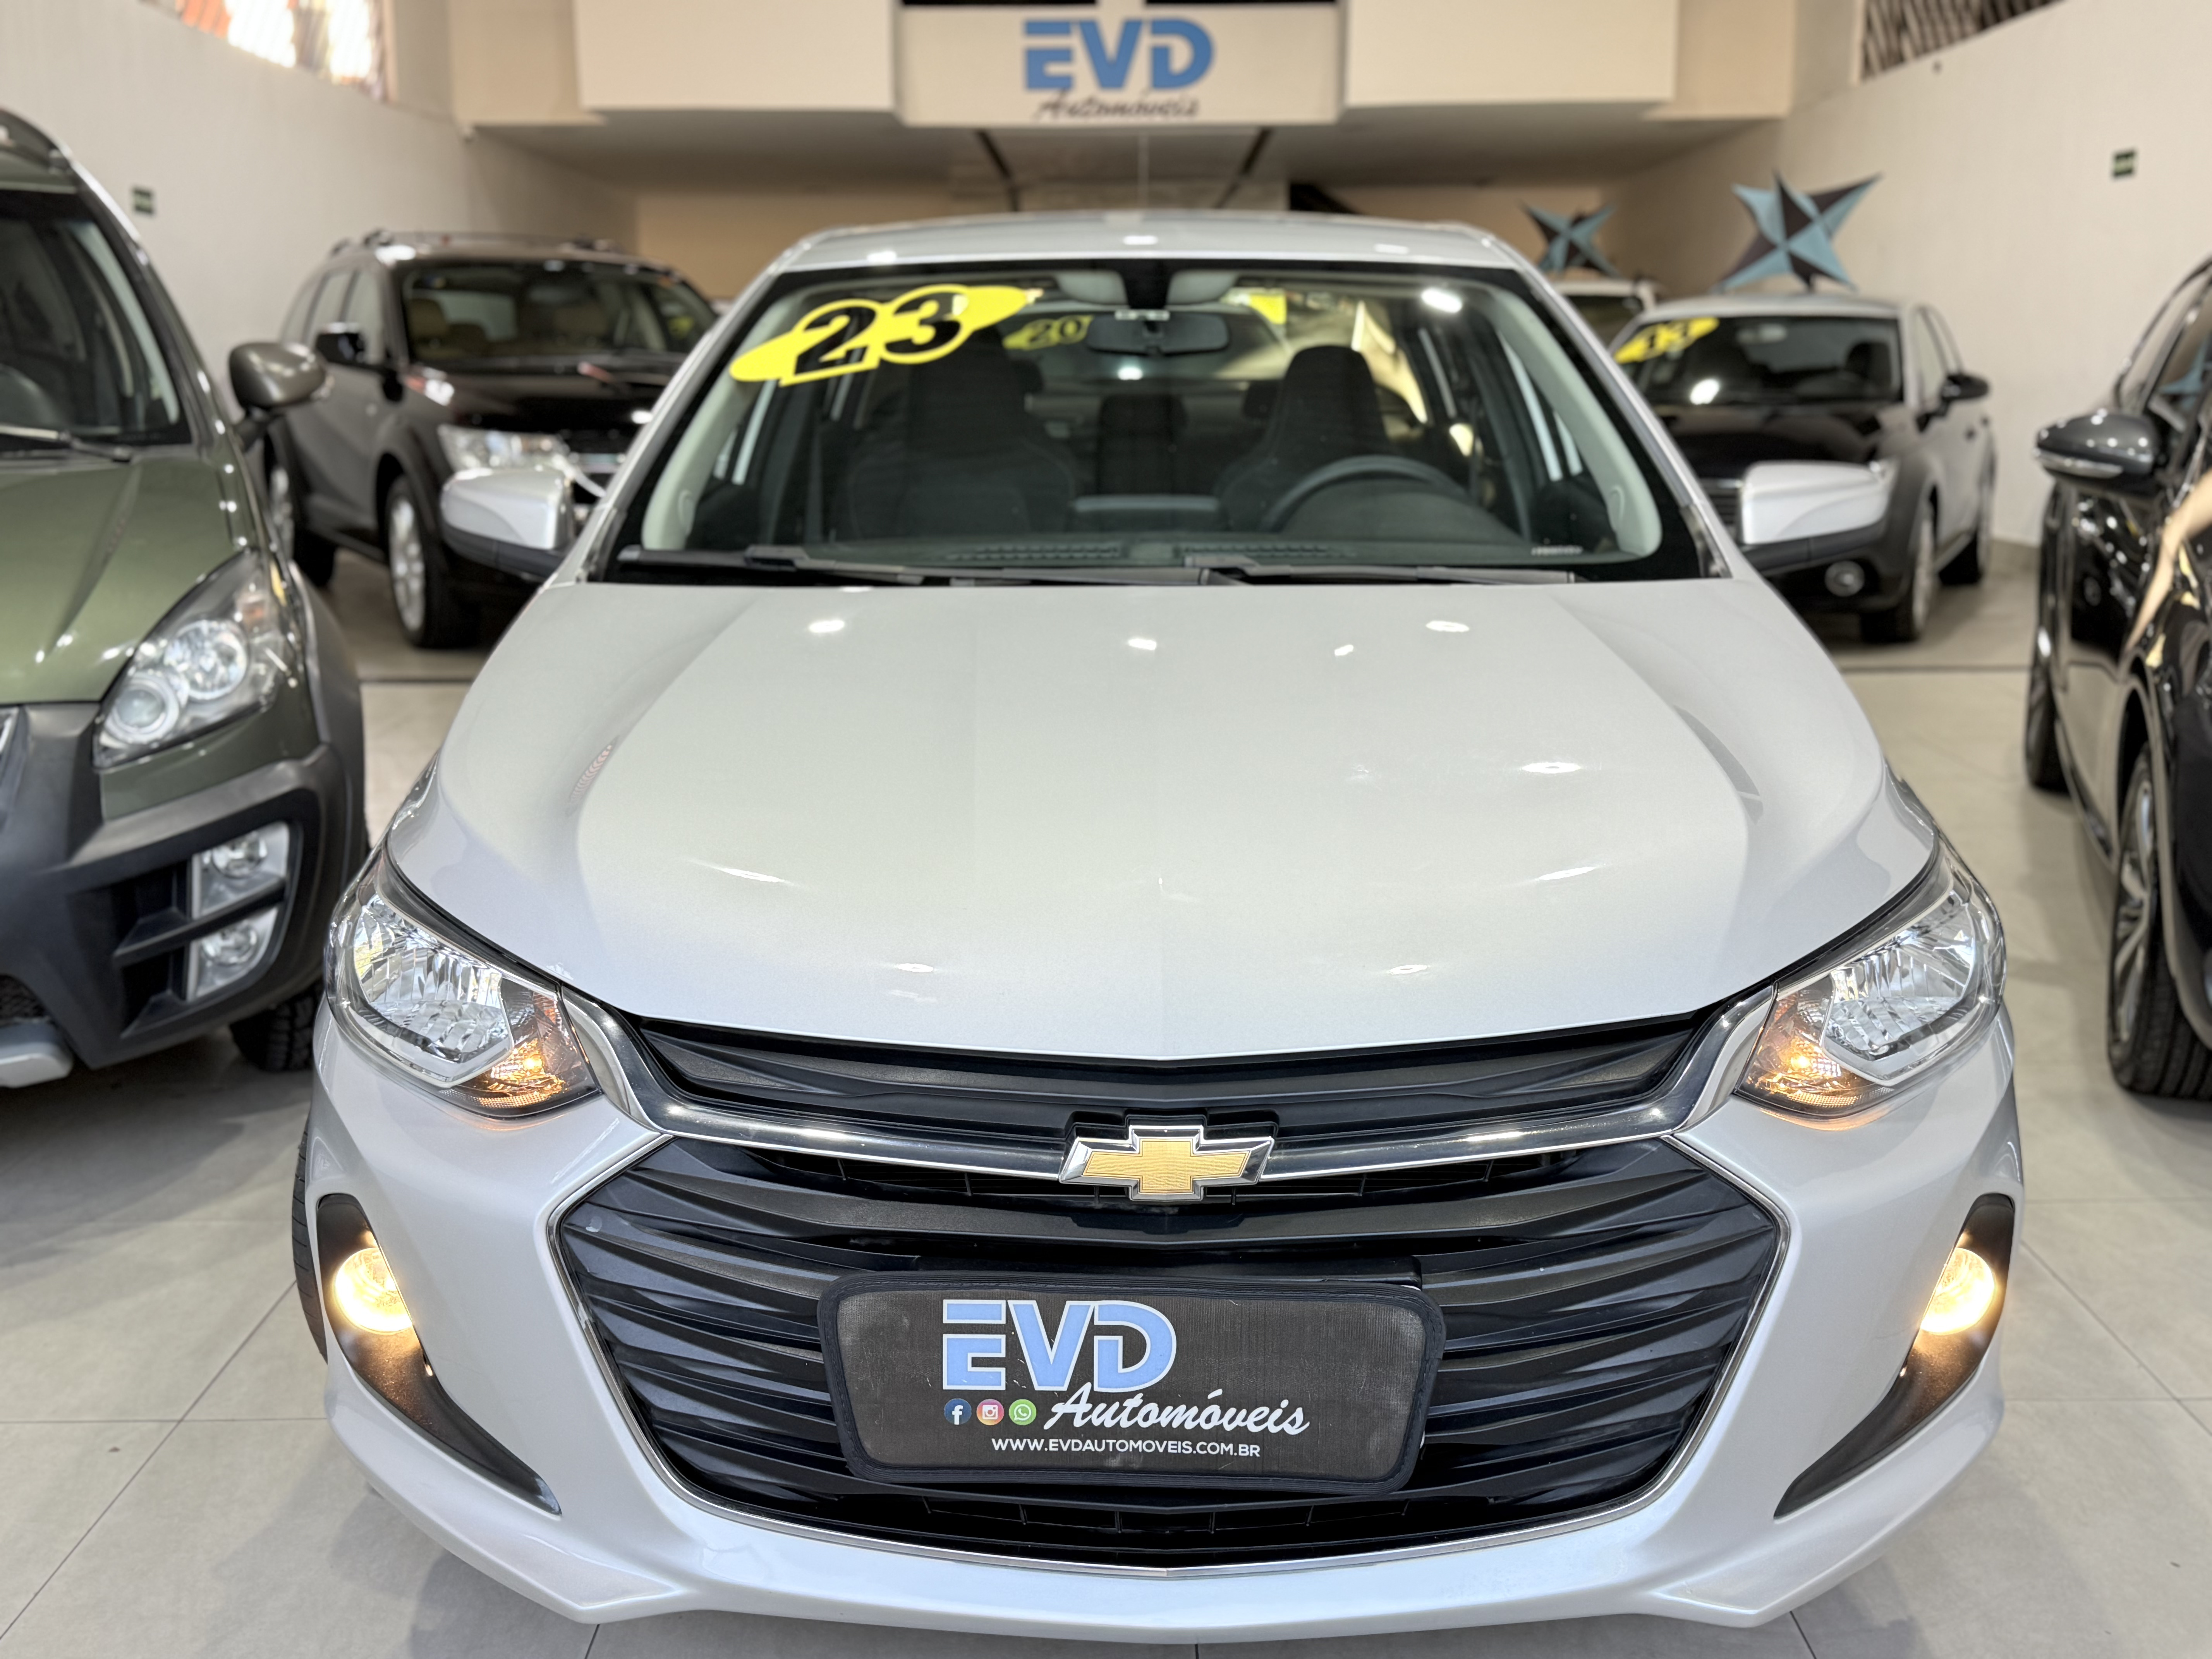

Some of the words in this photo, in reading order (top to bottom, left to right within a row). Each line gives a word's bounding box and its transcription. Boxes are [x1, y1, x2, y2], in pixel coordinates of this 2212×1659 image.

[1024, 19, 1214, 90] EVD
[793, 291, 962, 376] 23
[1027, 318, 1084, 346] 20
[942, 1299, 1177, 1393] EVD
[1043, 1382, 1310, 1436] Automóveis
[991, 1438, 1261, 1457] WWW.EVDAUTOMOVEIS.COM.BR
